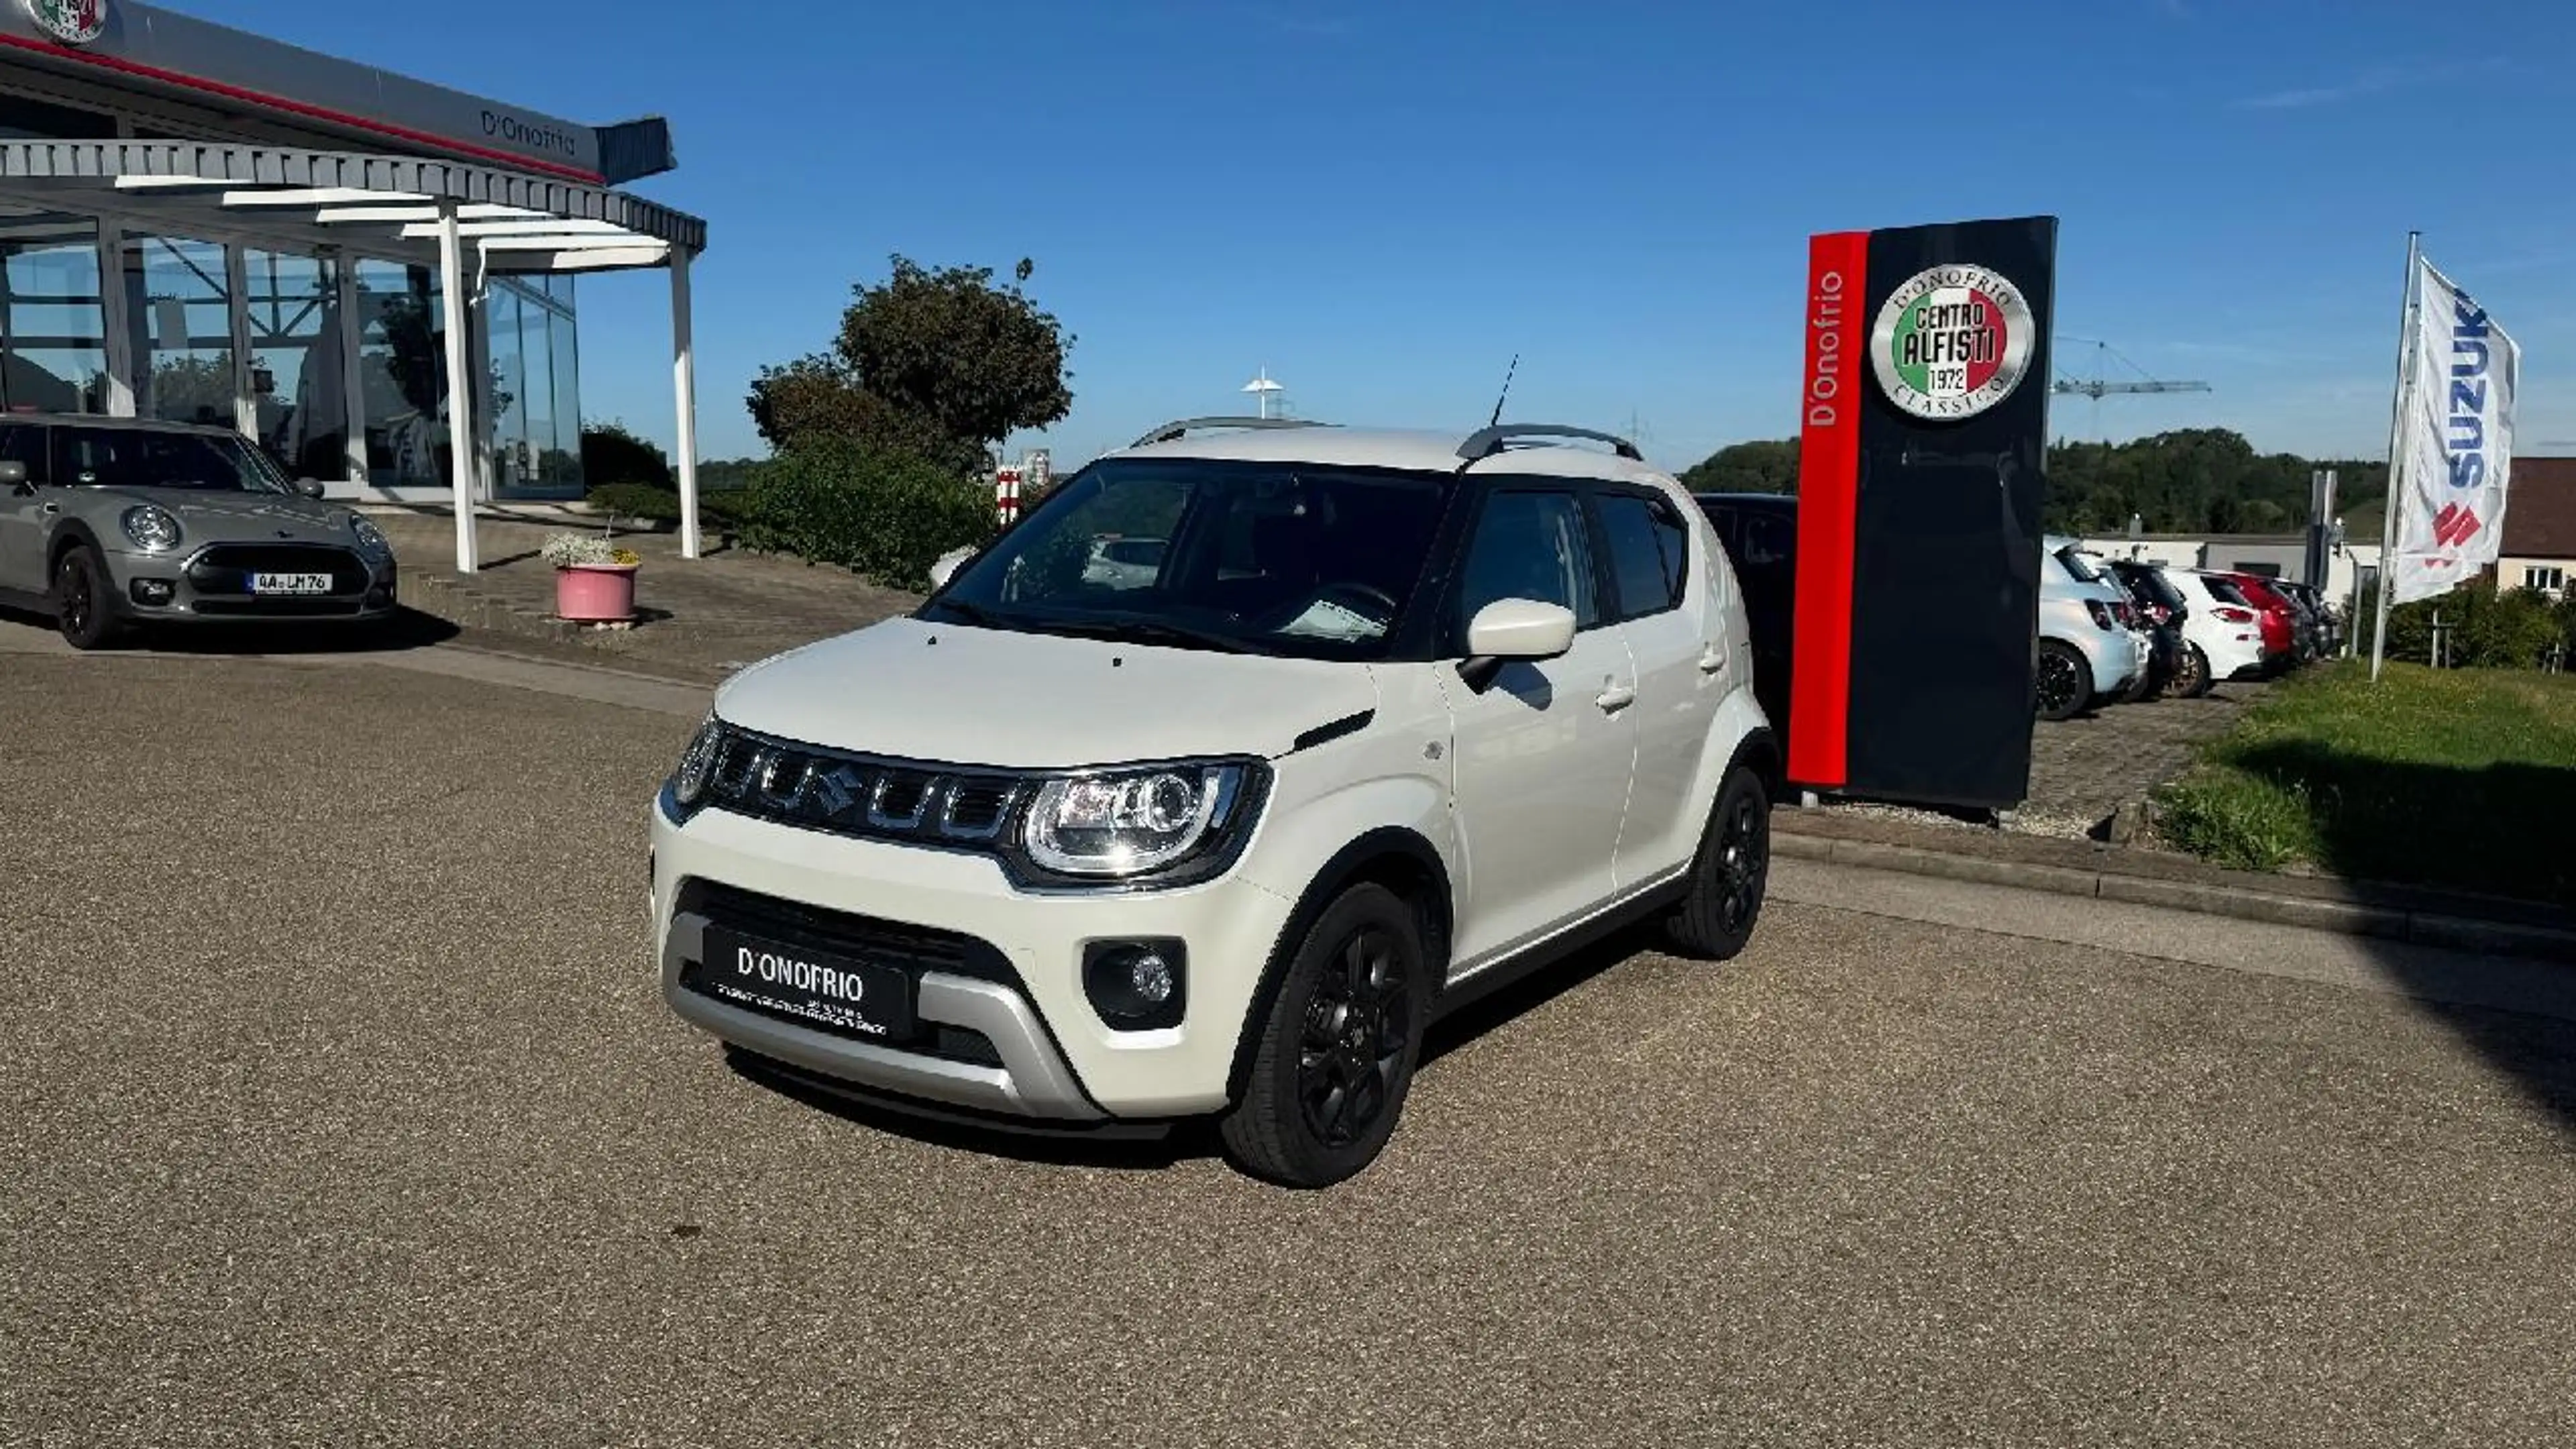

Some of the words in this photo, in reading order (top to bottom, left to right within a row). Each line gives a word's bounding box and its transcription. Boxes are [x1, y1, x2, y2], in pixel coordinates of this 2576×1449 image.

[1894, 268, 2012, 309] D'ONOFRIO
[1915, 303, 1984, 329] CENTRO
[1809, 270, 1843, 427] D'Onofrio
[1903, 328, 1994, 366] ALFISTI
[1929, 368, 1966, 390] 1972
